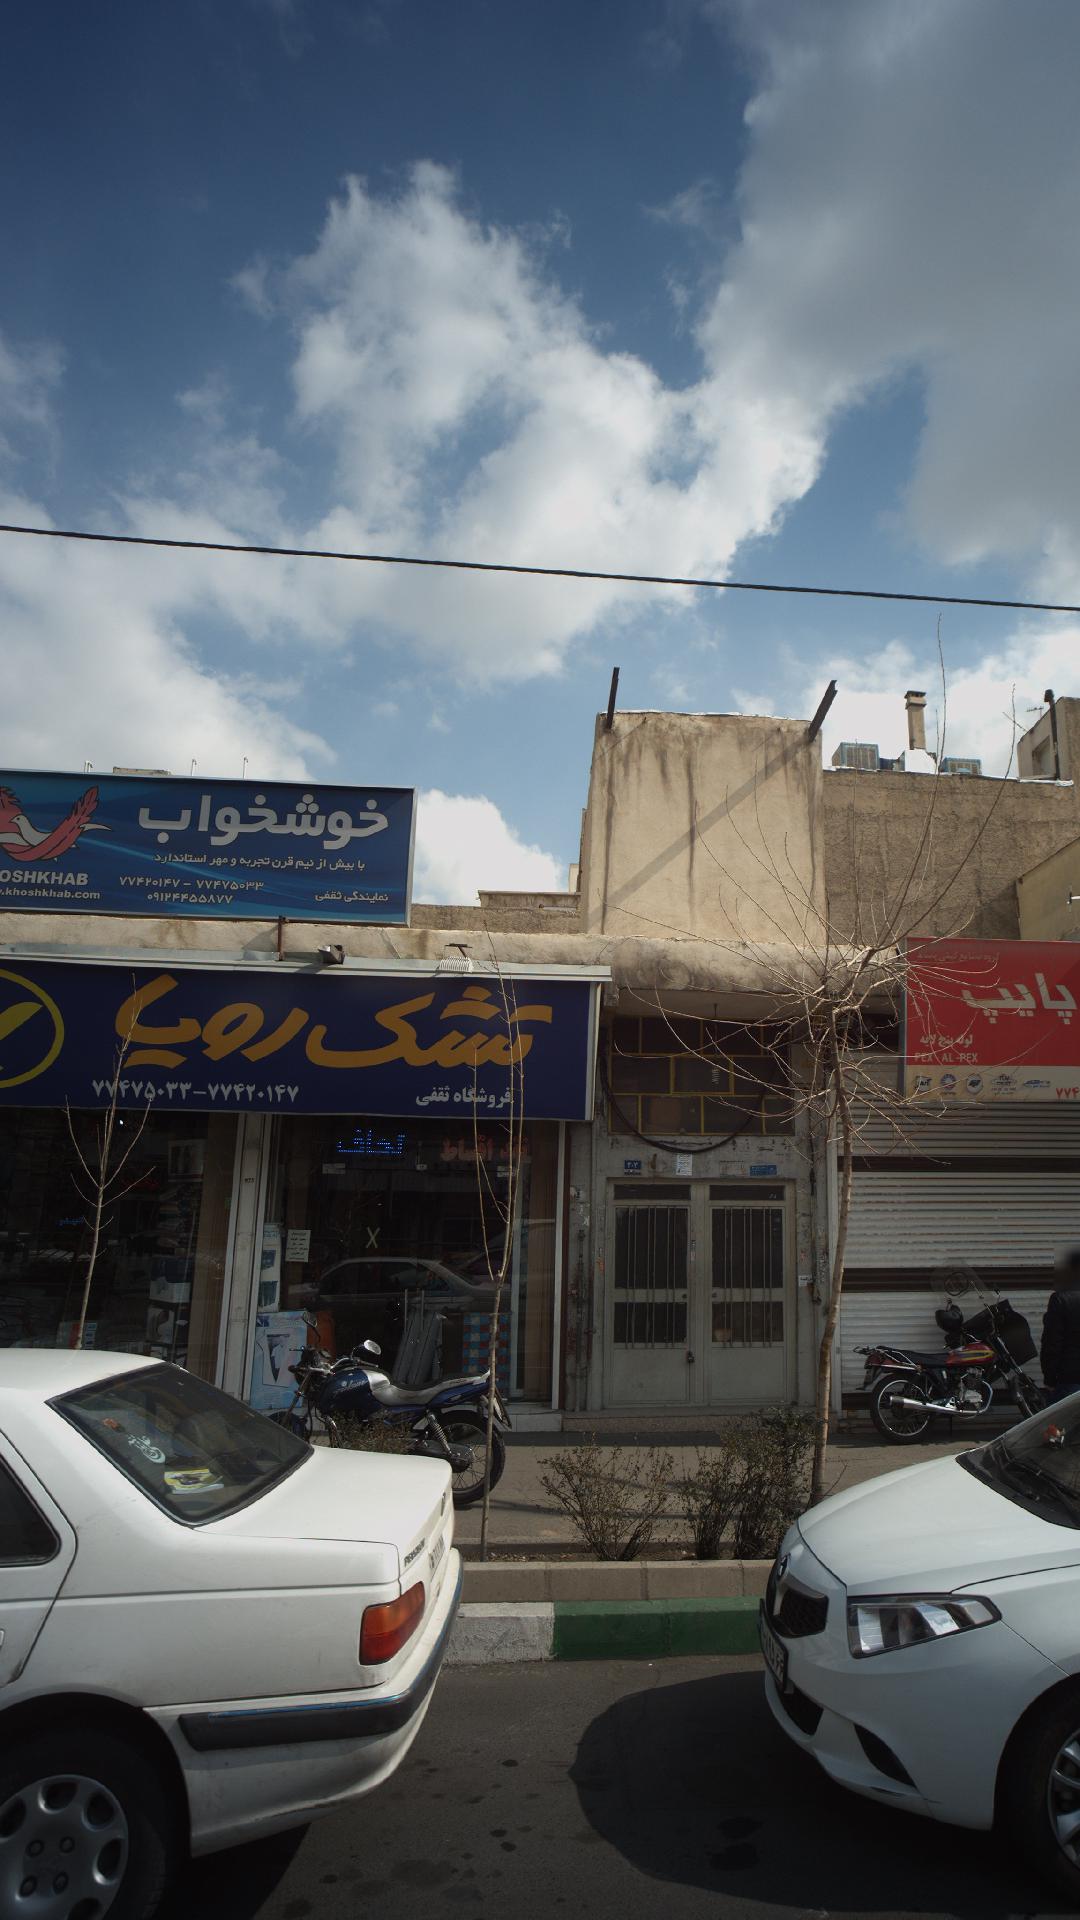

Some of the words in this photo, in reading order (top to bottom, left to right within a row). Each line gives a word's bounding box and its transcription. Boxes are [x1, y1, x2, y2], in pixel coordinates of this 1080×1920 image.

[138, 793, 389, 850] خوشخواب
[153, 853, 207, 865] استاندارد
[209, 857, 228, 867] مهر
[230, 857, 237, 867] و
[240, 856, 270, 869] تجربه
[272, 856, 294, 868] قرن
[295, 858, 314, 869] نیم
[316, 858, 327, 870] از
[329, 858, 354, 871] بیش
[356, 859, 366, 870] با
[315, 890, 342, 902] ثقفی
[343, 891, 389, 904] نمایندگی
[115, 973, 309, 1070] رویا
[306, 986, 553, 1069] تشک
[415, 1085, 451, 1106] ثقفی
[454, 1084, 514, 1108] فروشگاه
